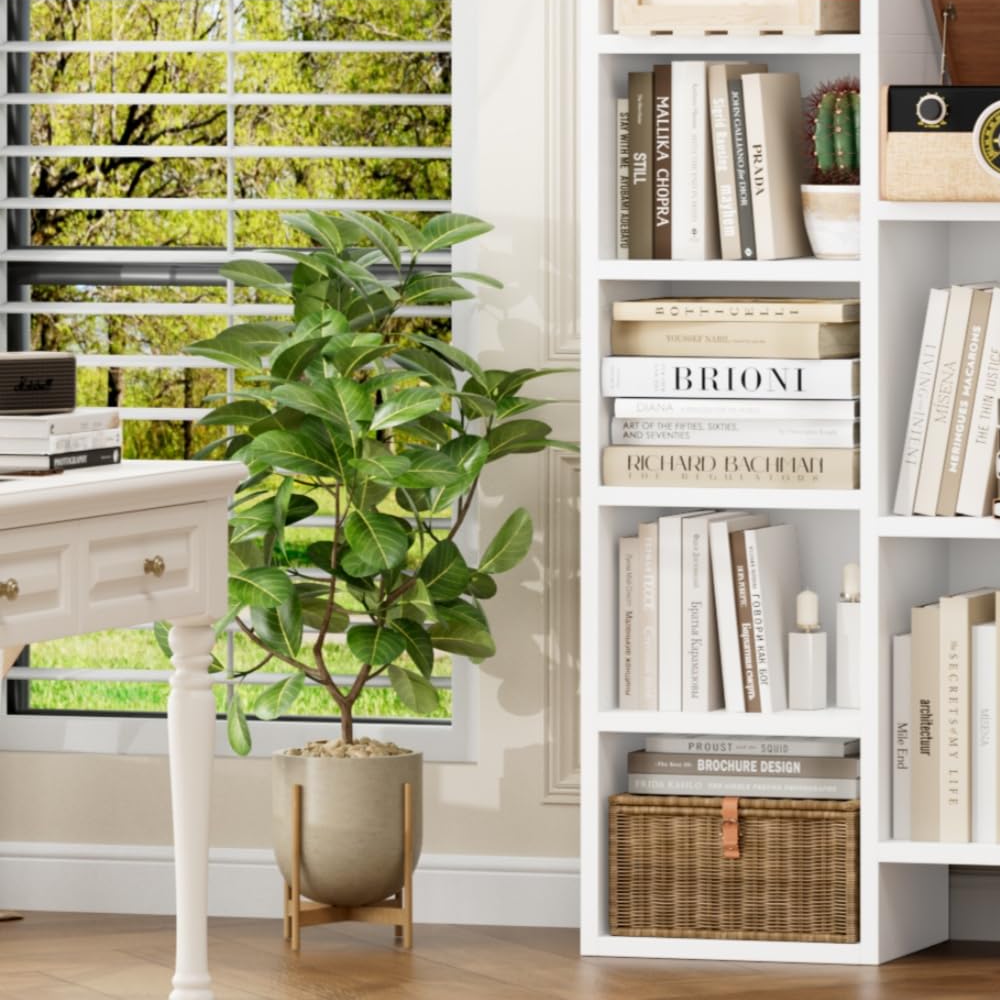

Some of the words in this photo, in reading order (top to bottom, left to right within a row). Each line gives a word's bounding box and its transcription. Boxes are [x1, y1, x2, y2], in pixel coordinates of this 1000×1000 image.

[712, 97, 725, 127] Sigrid
[731, 91, 741, 117] JOHN
[656, 96, 669, 161] MALLIKA
[715, 132, 728, 172] Rausing
[733, 119, 745, 168] GALLIANO
[633, 153, 647, 185] STILL
[736, 169, 746, 180] for
[752, 144, 765, 196] PRADA
[656, 169, 669, 226] CHOPRA
[739, 182, 748, 206] DIOR
[719, 185, 736, 237] mayhem
[655, 306, 799, 316] BOTTICELLI
[674, 367, 806, 392] BRIONI
[948, 401, 969, 473] MERINGUES
[963, 325, 982, 396] MACARONS
[980, 395, 993, 420] THIN
[623, 422, 639, 431] ART
[642, 422, 654, 431] OF
[657, 422, 673, 430] THE
[623, 431, 643, 439] AND
[646, 431, 690, 439] SEVENTIES
[976, 426, 989, 445] THE
[627, 455, 716, 472] RICHARD
[724, 456, 823, 473] BACHMAN
[690, 601, 702, 635] Братья
[752, 594, 764, 641] ГОВОРИ
[624, 611, 633, 655] Маленькие
[756, 645, 765, 664] КАК
[624, 658, 633, 696] женщины
[758, 669, 768, 685] БОГ
[948, 653, 959, 725] SECRETS
[897, 723, 908, 744] Mile
[920, 700, 933, 756] architectuur
[688, 742, 732, 752] PROUST
[761, 744, 788, 753] SQUID
[897, 748, 908, 769] End
[949, 737, 959, 759] MY
[697, 759, 757, 773] BROCHURE
[761, 760, 800, 773] DESIGN
[949, 770, 959, 806] LIFE
